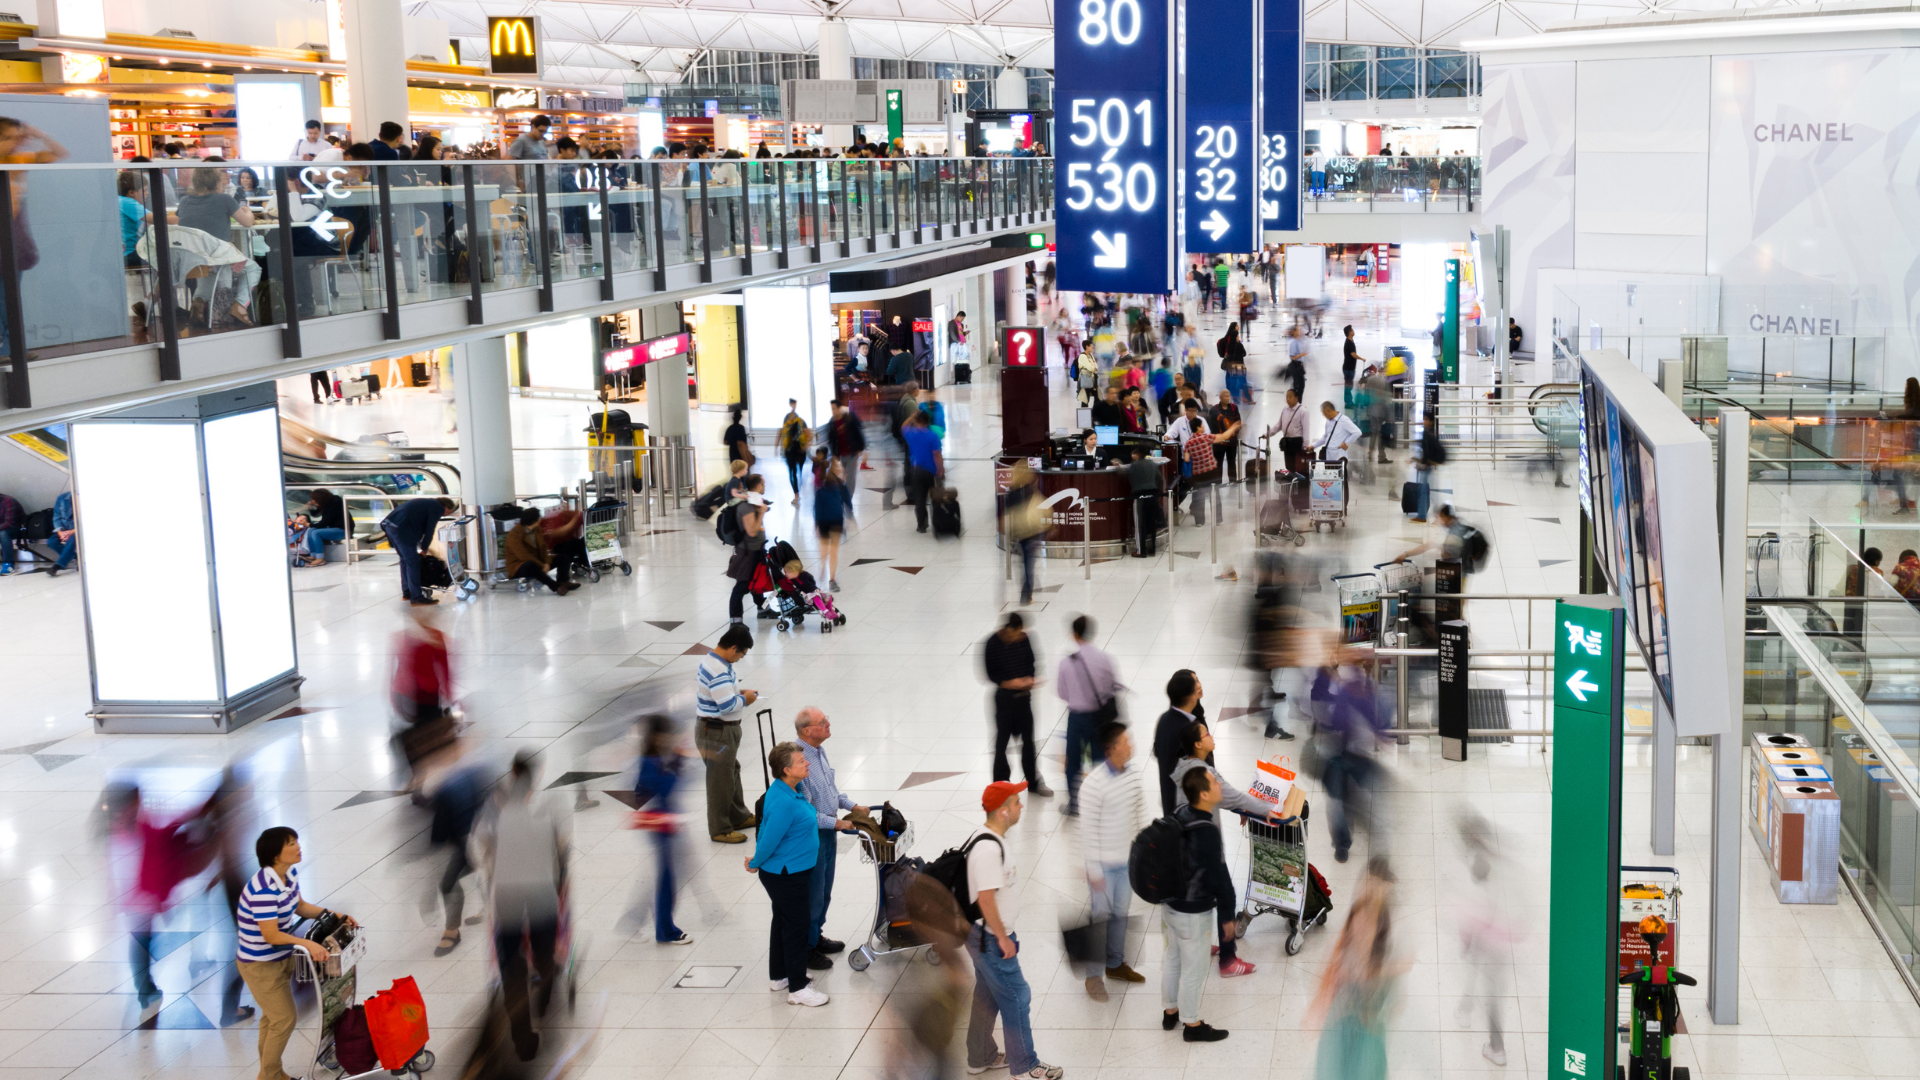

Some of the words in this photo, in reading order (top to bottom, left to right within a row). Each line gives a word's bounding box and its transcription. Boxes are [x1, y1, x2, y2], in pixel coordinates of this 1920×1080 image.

[1079, 0, 1141, 45] 80
[1070, 98, 1152, 147] 501
[1754, 122, 1854, 143] CHANEL
[1196, 125, 1237, 158] 20
[1067, 162, 1156, 212] 530
[1196, 168, 1237, 201] 32
[914, 322, 932, 330] SALE
[1750, 314, 1847, 336] CHANEL
